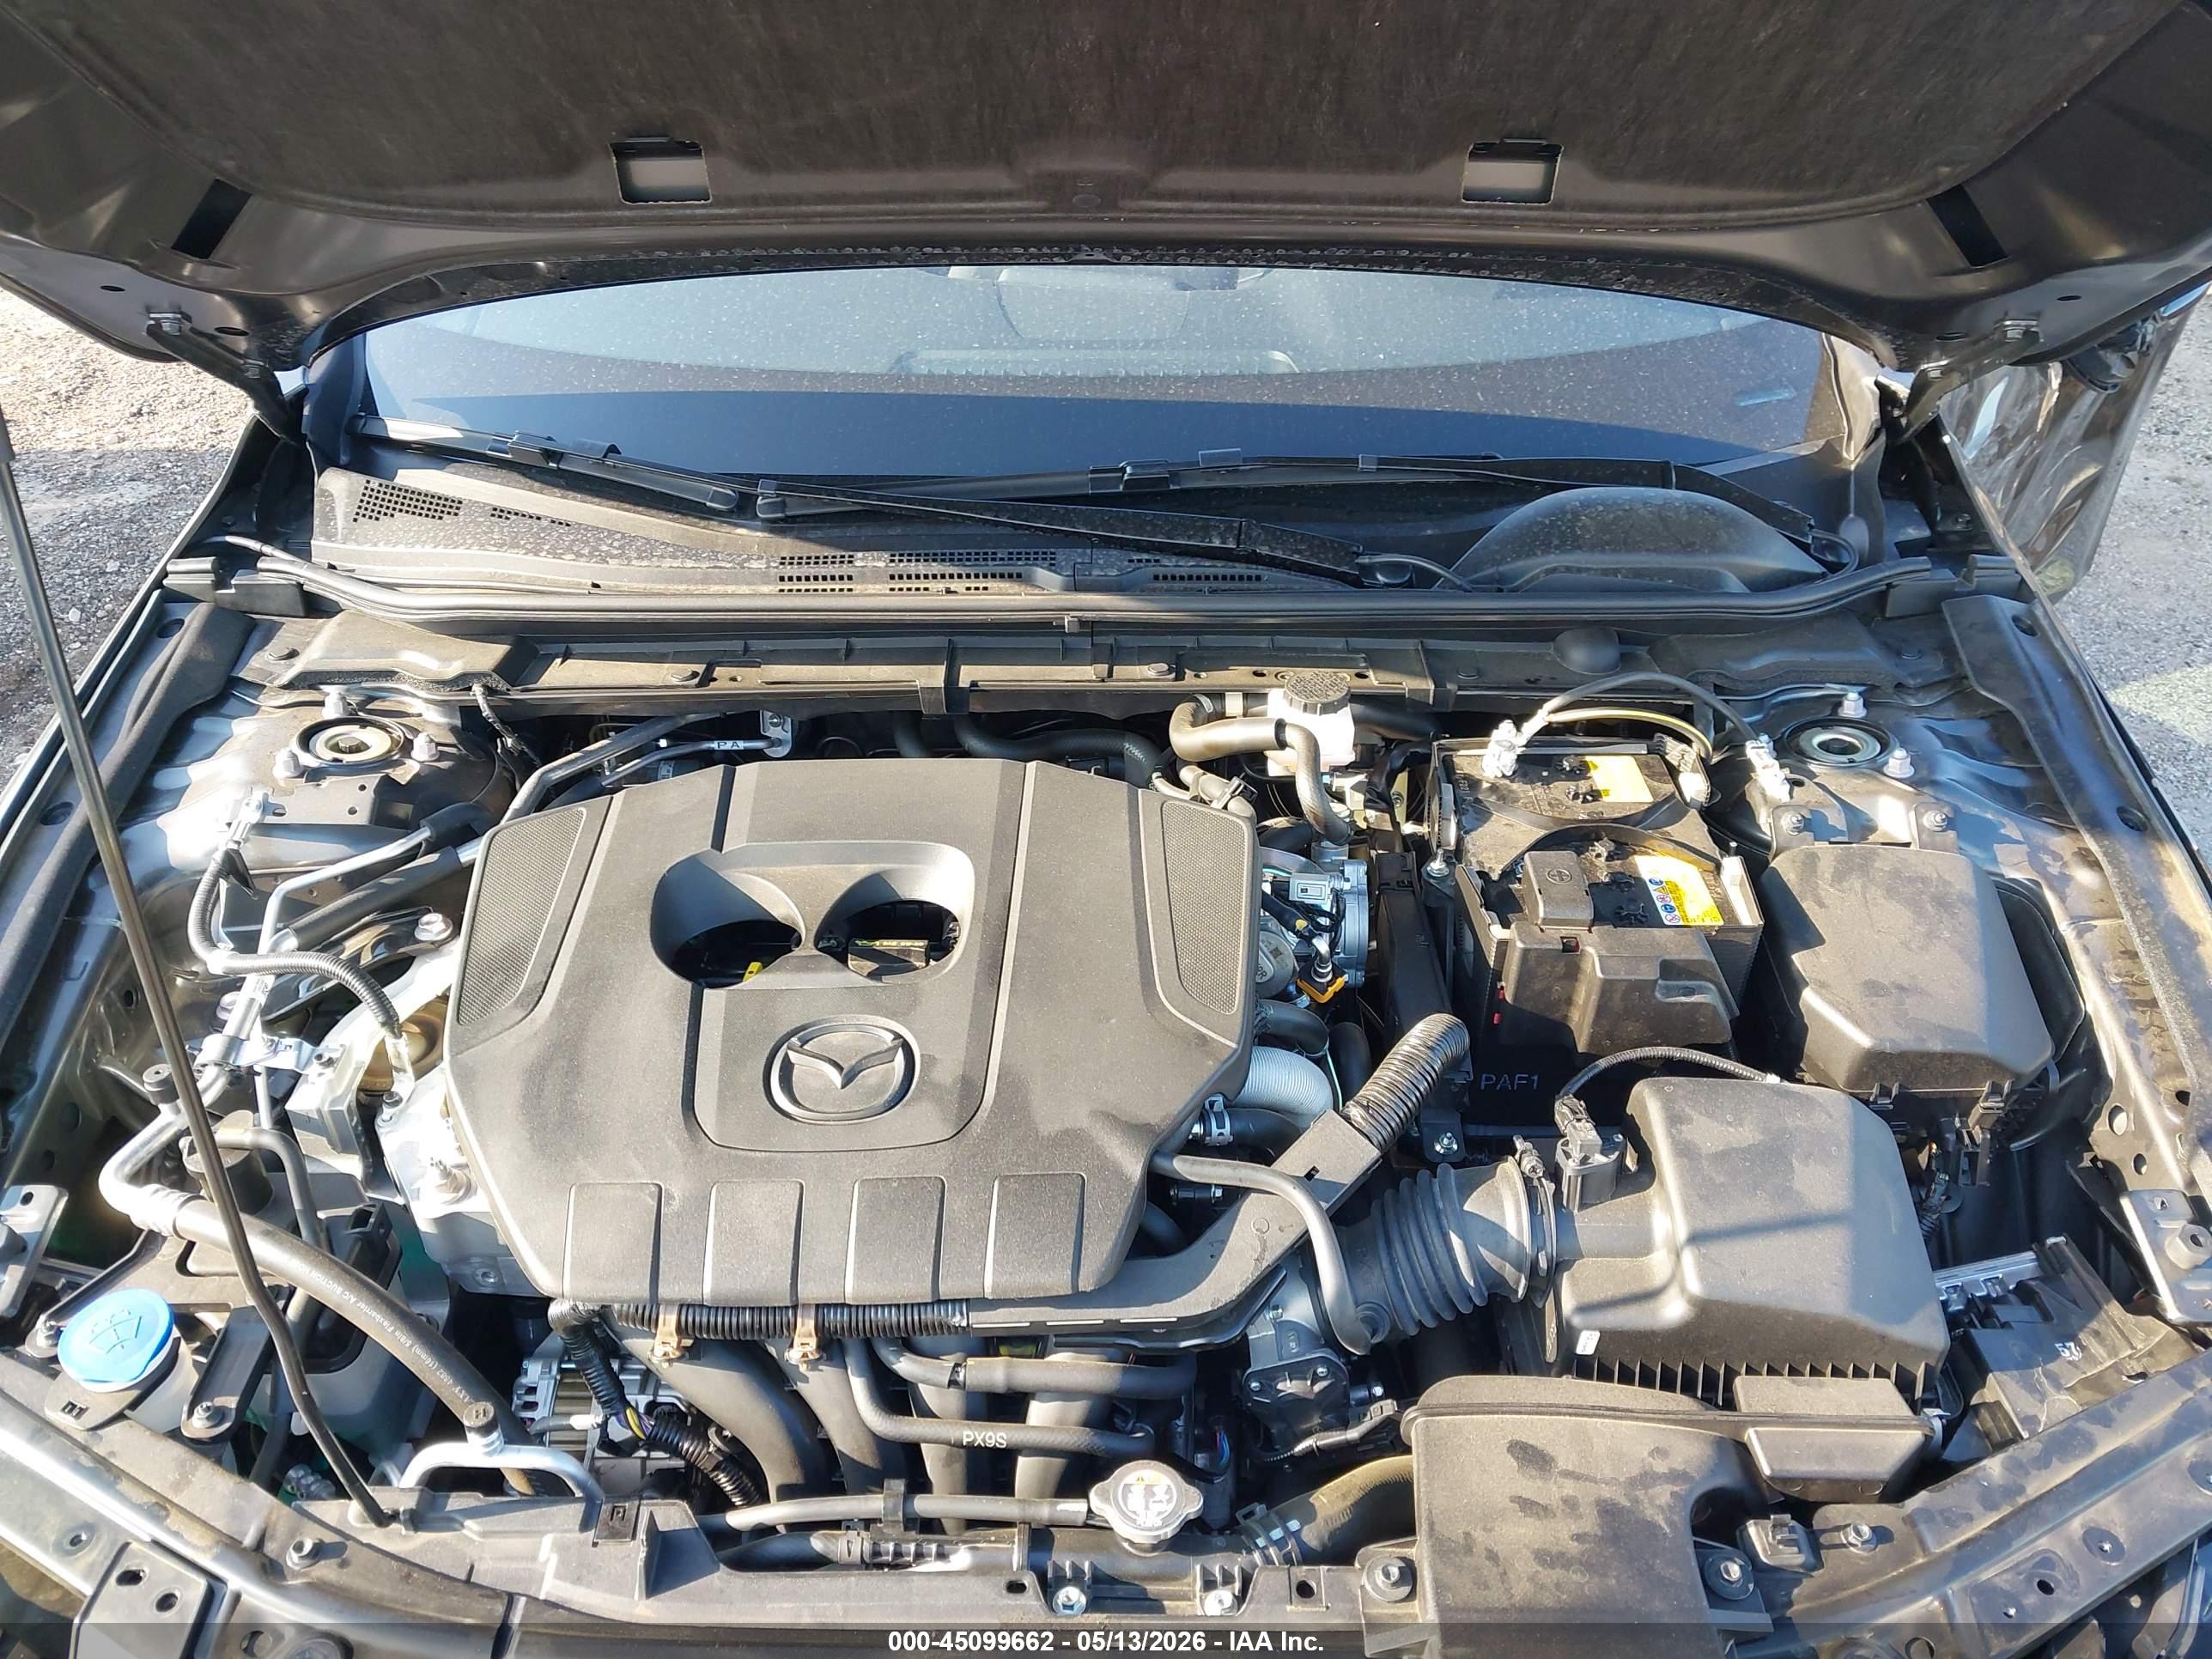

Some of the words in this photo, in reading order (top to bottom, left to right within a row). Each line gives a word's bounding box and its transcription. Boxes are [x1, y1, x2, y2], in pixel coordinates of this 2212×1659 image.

[1480, 1073, 1540, 1091] PAF1
[310, 1270, 343, 1295] SUCTION
[962, 1430, 1007, 1448] PX9S
